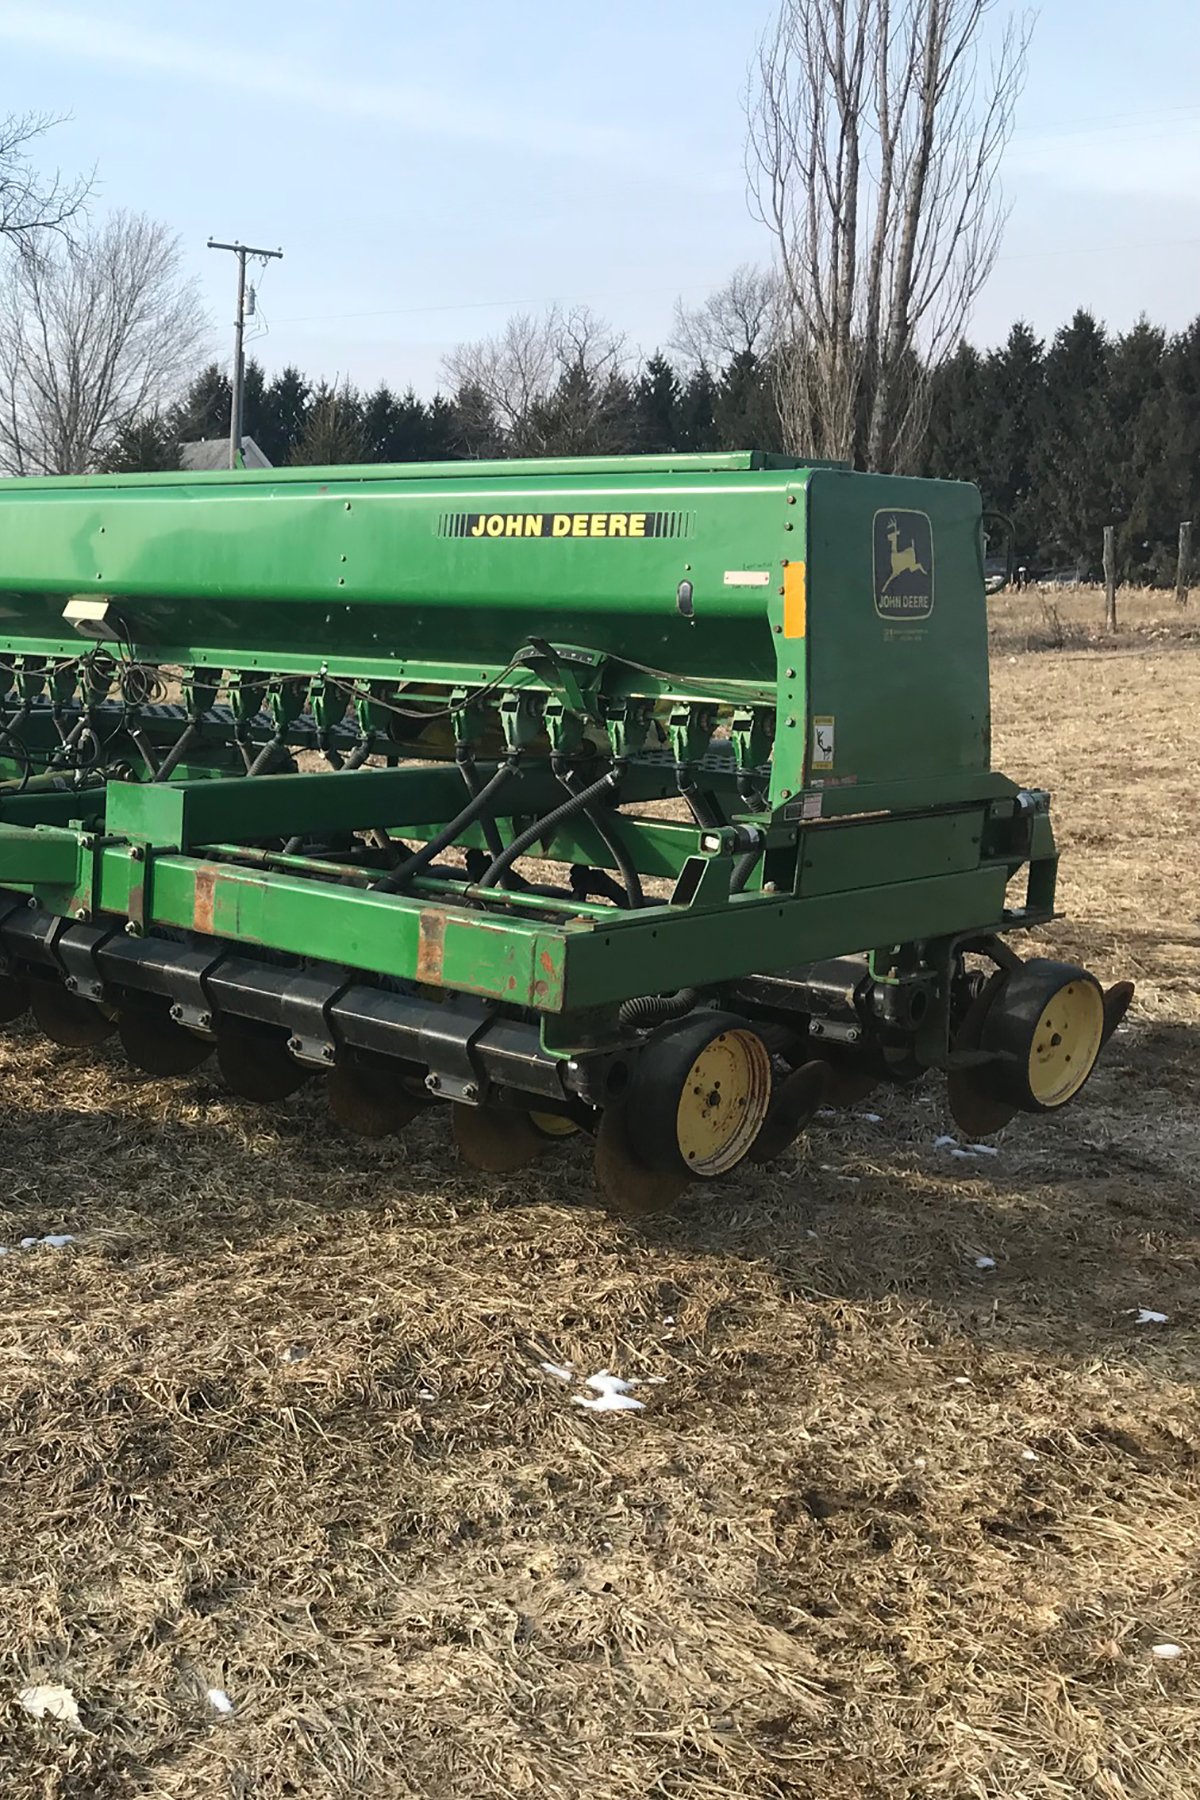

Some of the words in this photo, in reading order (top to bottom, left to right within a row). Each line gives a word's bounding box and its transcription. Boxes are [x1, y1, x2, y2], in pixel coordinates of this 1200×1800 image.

[471, 514, 543, 537] JOHN
[552, 513, 647, 537] DEERE
[878, 595, 901, 608] JOHN
[902, 595, 928, 608] DEERE
